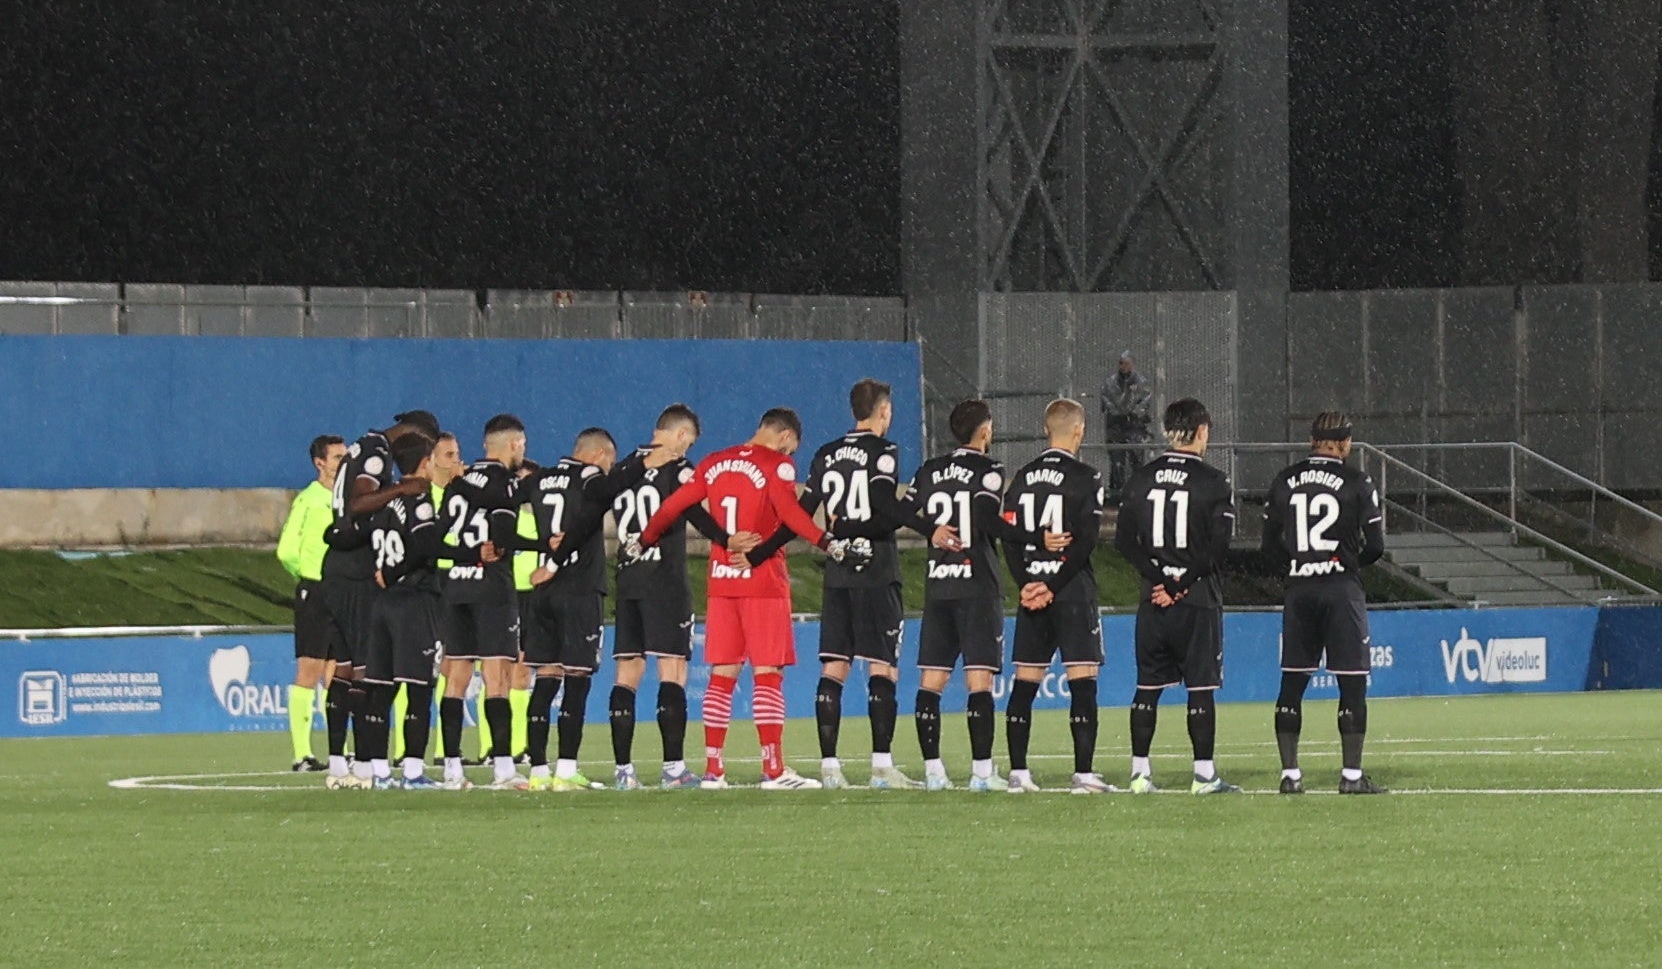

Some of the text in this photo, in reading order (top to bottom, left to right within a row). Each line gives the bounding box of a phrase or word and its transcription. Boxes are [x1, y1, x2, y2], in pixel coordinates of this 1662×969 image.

[822, 470, 872, 522] 24
[1026, 468, 1065, 486] DARKO
[1155, 468, 1189, 486] CRUZ
[542, 493, 565, 534] 7
[614, 485, 661, 545] 20
[721, 496, 737, 536] 1
[927, 491, 972, 548] 21
[1018, 493, 1063, 551] 14
[1147, 489, 1190, 548] 11
[1290, 493, 1340, 552] 12
[1496, 651, 1540, 670] videoluc
